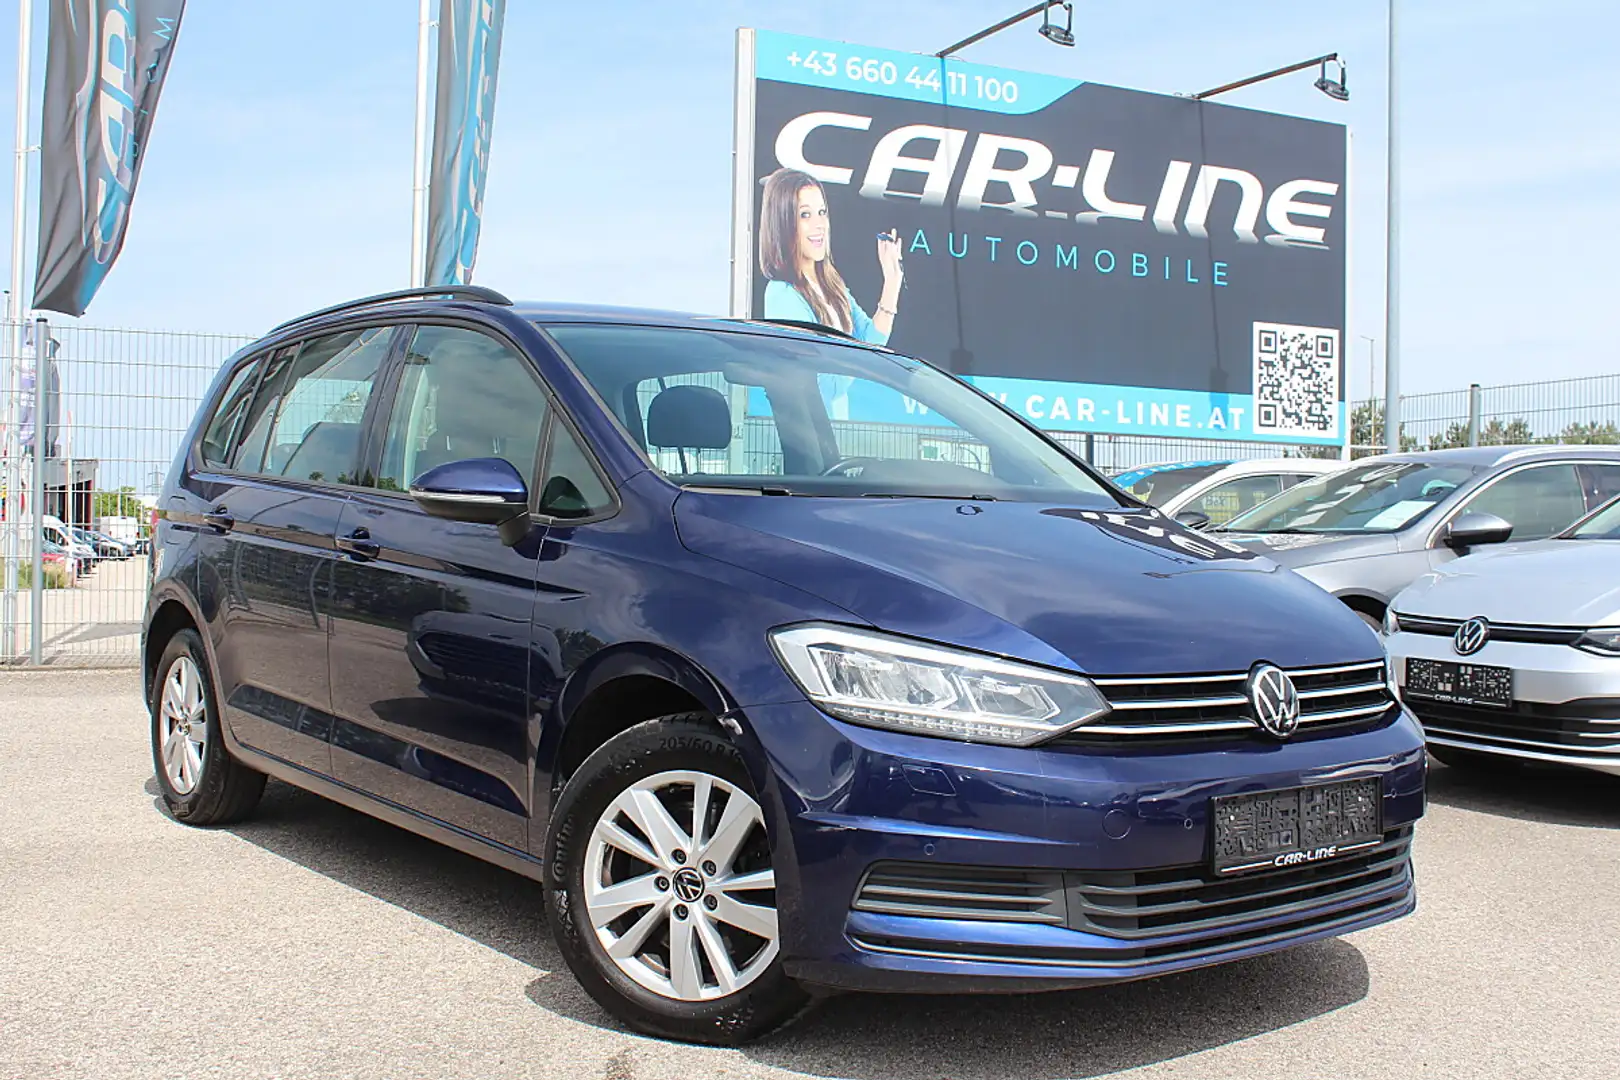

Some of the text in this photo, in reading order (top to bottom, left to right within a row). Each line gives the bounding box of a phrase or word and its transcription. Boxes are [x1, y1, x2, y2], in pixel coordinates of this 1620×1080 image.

[786, 51, 1018, 103] +43 660 44 11 100
[773, 111, 1340, 245] CAR-LINE
[910, 229, 1229, 286] AUTOMOBILE
[1274, 845, 1337, 867] CAR-LINE
